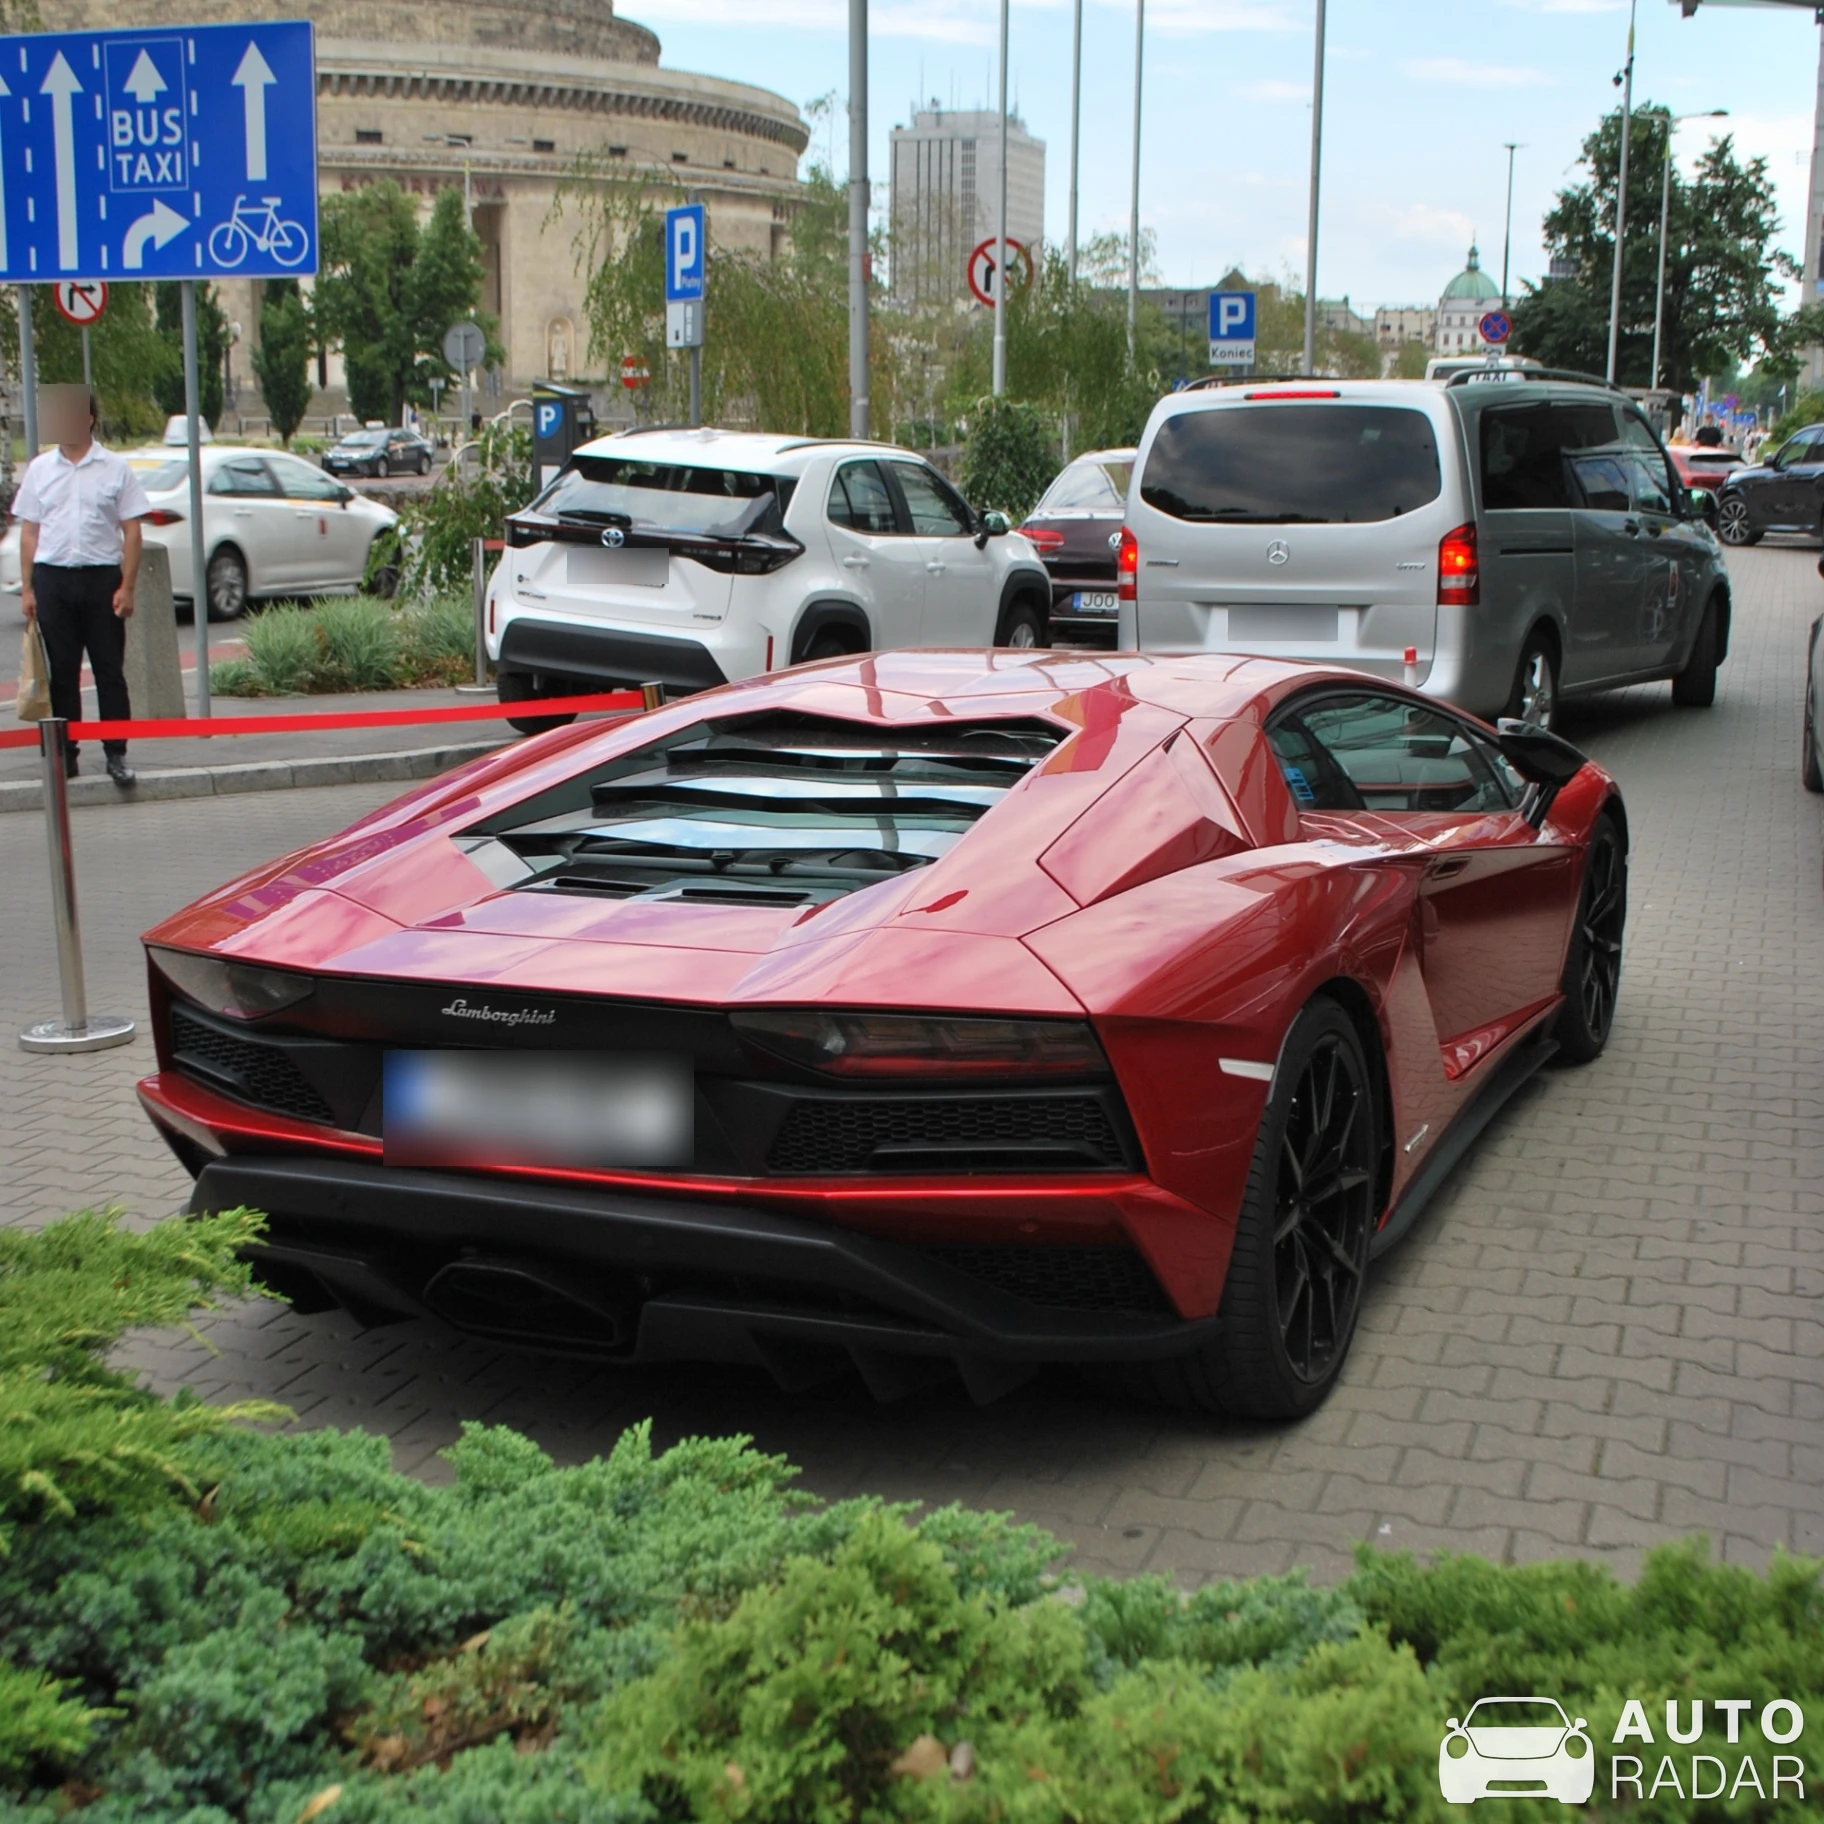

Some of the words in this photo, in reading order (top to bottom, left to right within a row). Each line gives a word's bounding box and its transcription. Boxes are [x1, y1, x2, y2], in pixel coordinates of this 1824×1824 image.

[112, 107, 182, 147] BUS
[115, 151, 182, 184] TAXI
[674, 216, 696, 290] P
[1220, 297, 1246, 336] P
[1211, 345, 1253, 359] Koniec
[540, 405, 556, 432] P
[441, 999, 556, 1027] Lamborghini
